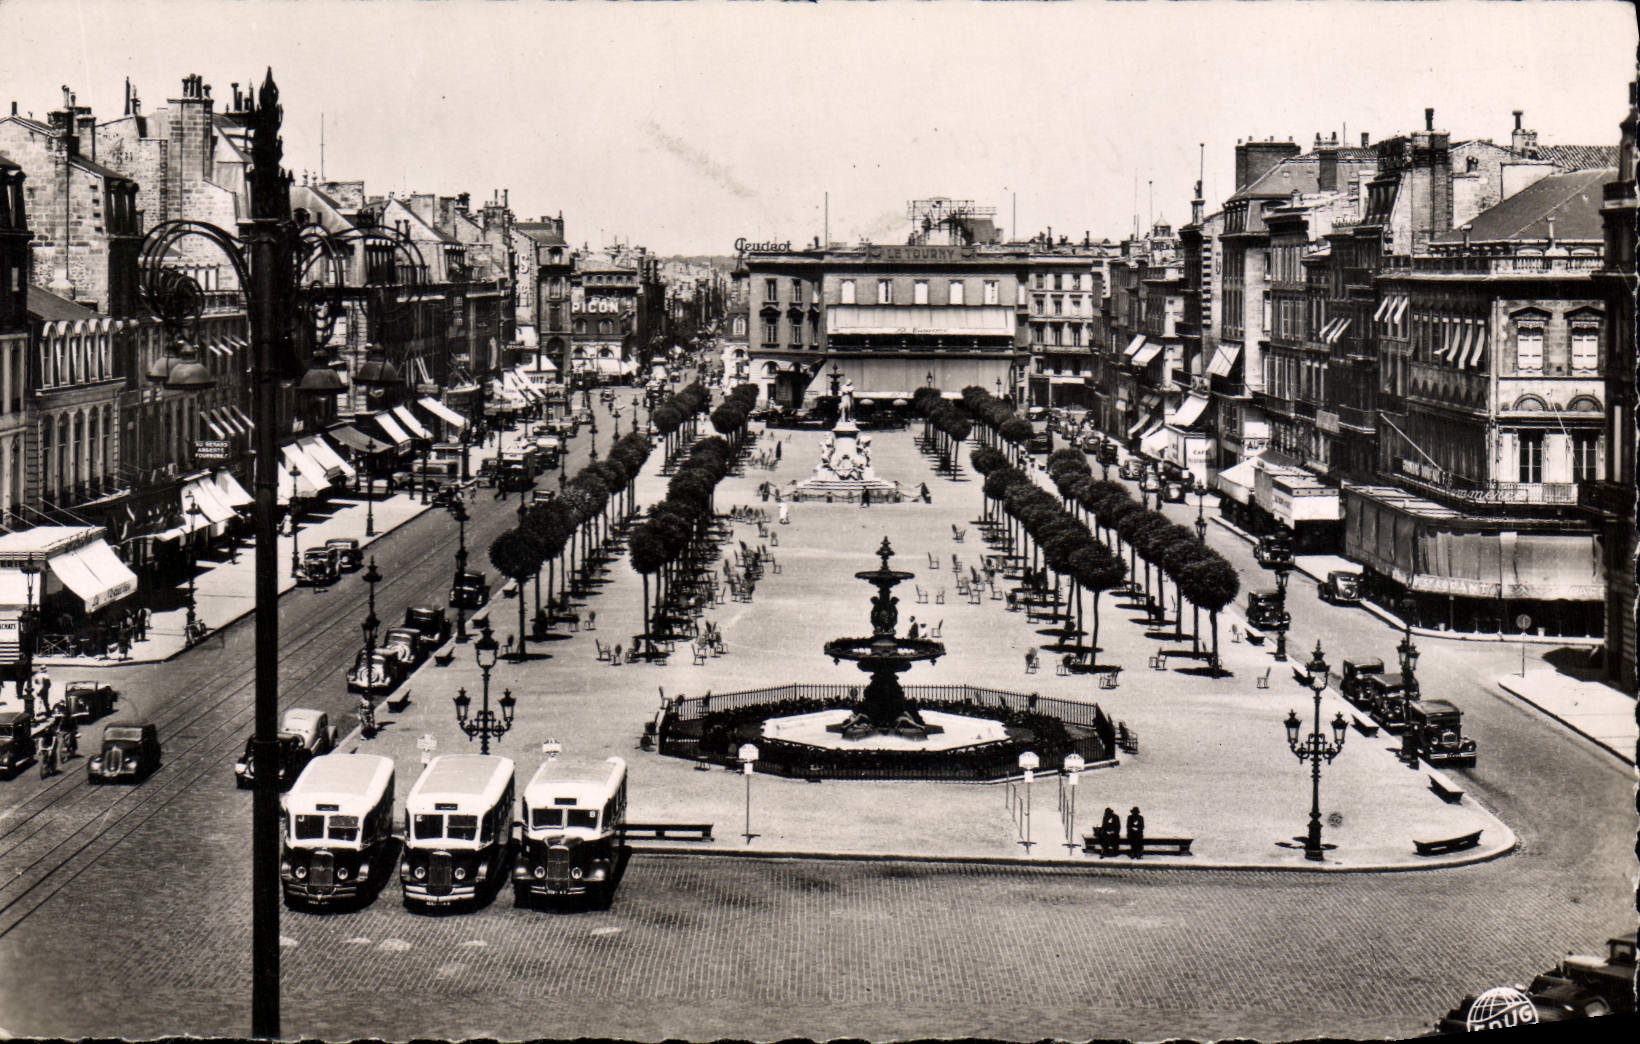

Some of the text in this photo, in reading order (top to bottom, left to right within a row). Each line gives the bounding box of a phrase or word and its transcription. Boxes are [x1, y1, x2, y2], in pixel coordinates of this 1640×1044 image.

[887, 248, 955, 259] LE TOURNY
[571, 300, 620, 314] PICON
[588, 810, 597, 819] B
